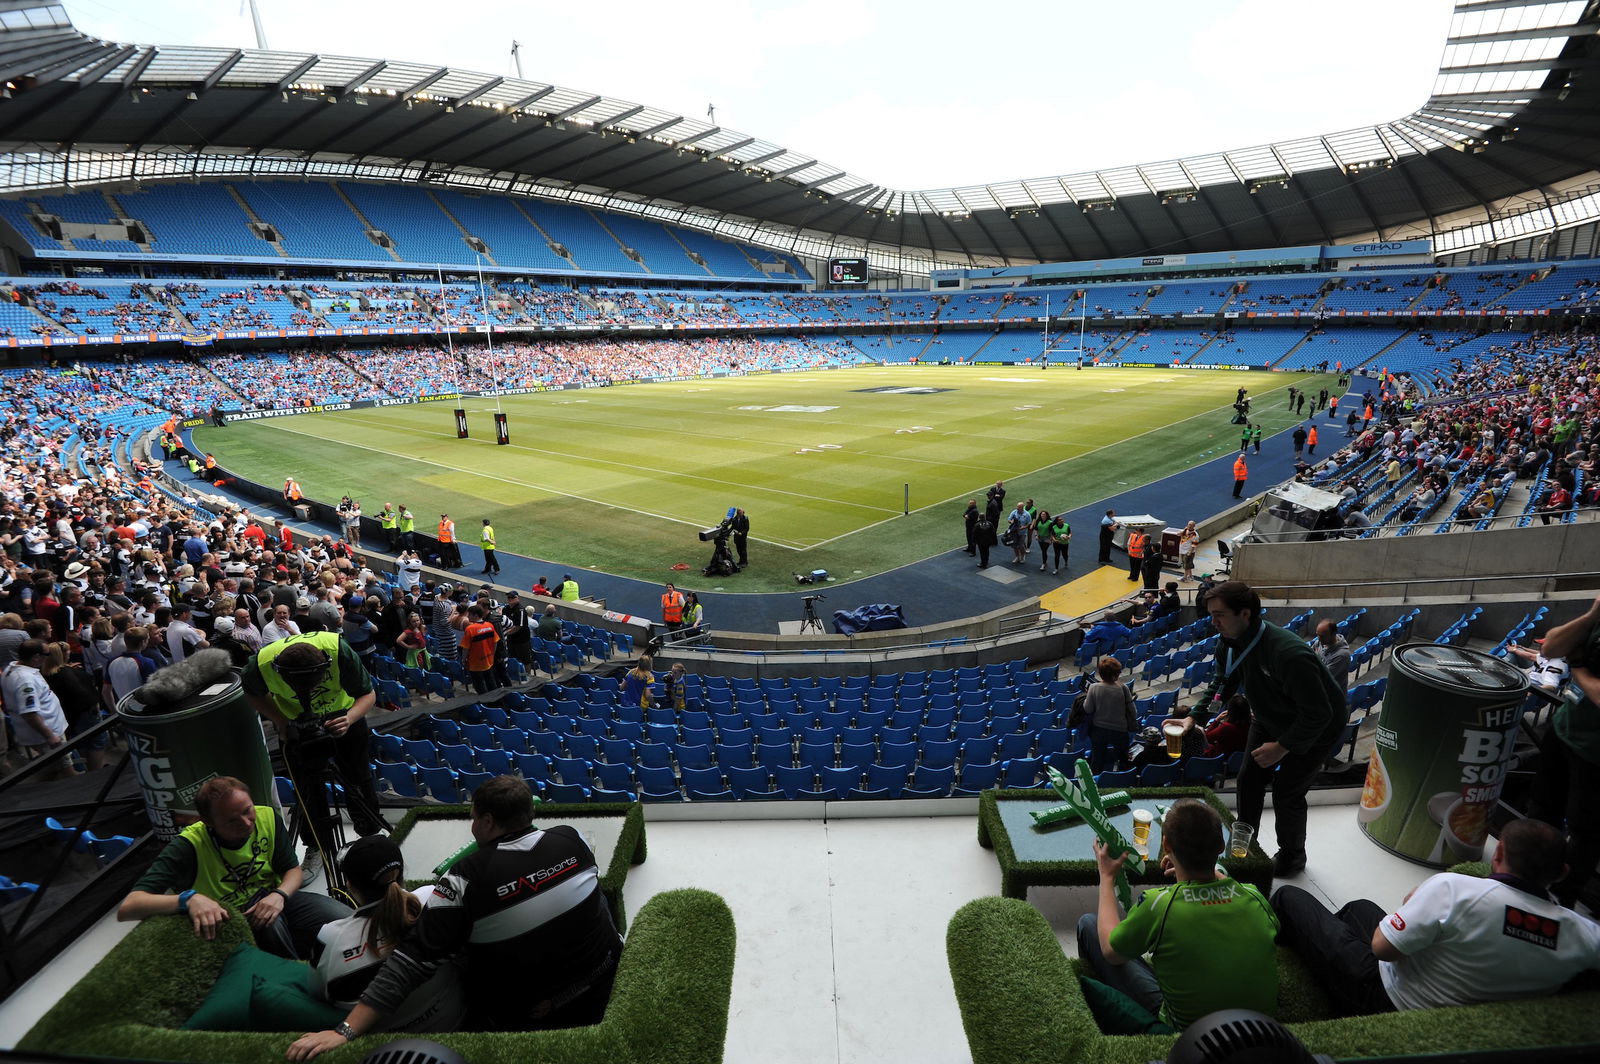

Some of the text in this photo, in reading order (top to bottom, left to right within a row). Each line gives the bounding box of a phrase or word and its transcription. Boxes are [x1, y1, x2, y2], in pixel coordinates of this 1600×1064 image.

[1352, 242, 1402, 252] ETIHAD
[480, 389, 505, 398] TRAIN
[526, 386, 546, 394] YOUR
[382, 397, 411, 406] BRUT
[225, 403, 351, 422] TRAIN WITH YOUR CLUB
[183, 418, 205, 428] PRIDE
[1458, 727, 1517, 765] BI
[1091, 806, 1111, 832] BIG
[251, 836, 269, 857] 63
[1182, 885, 1241, 903] ELONEX
